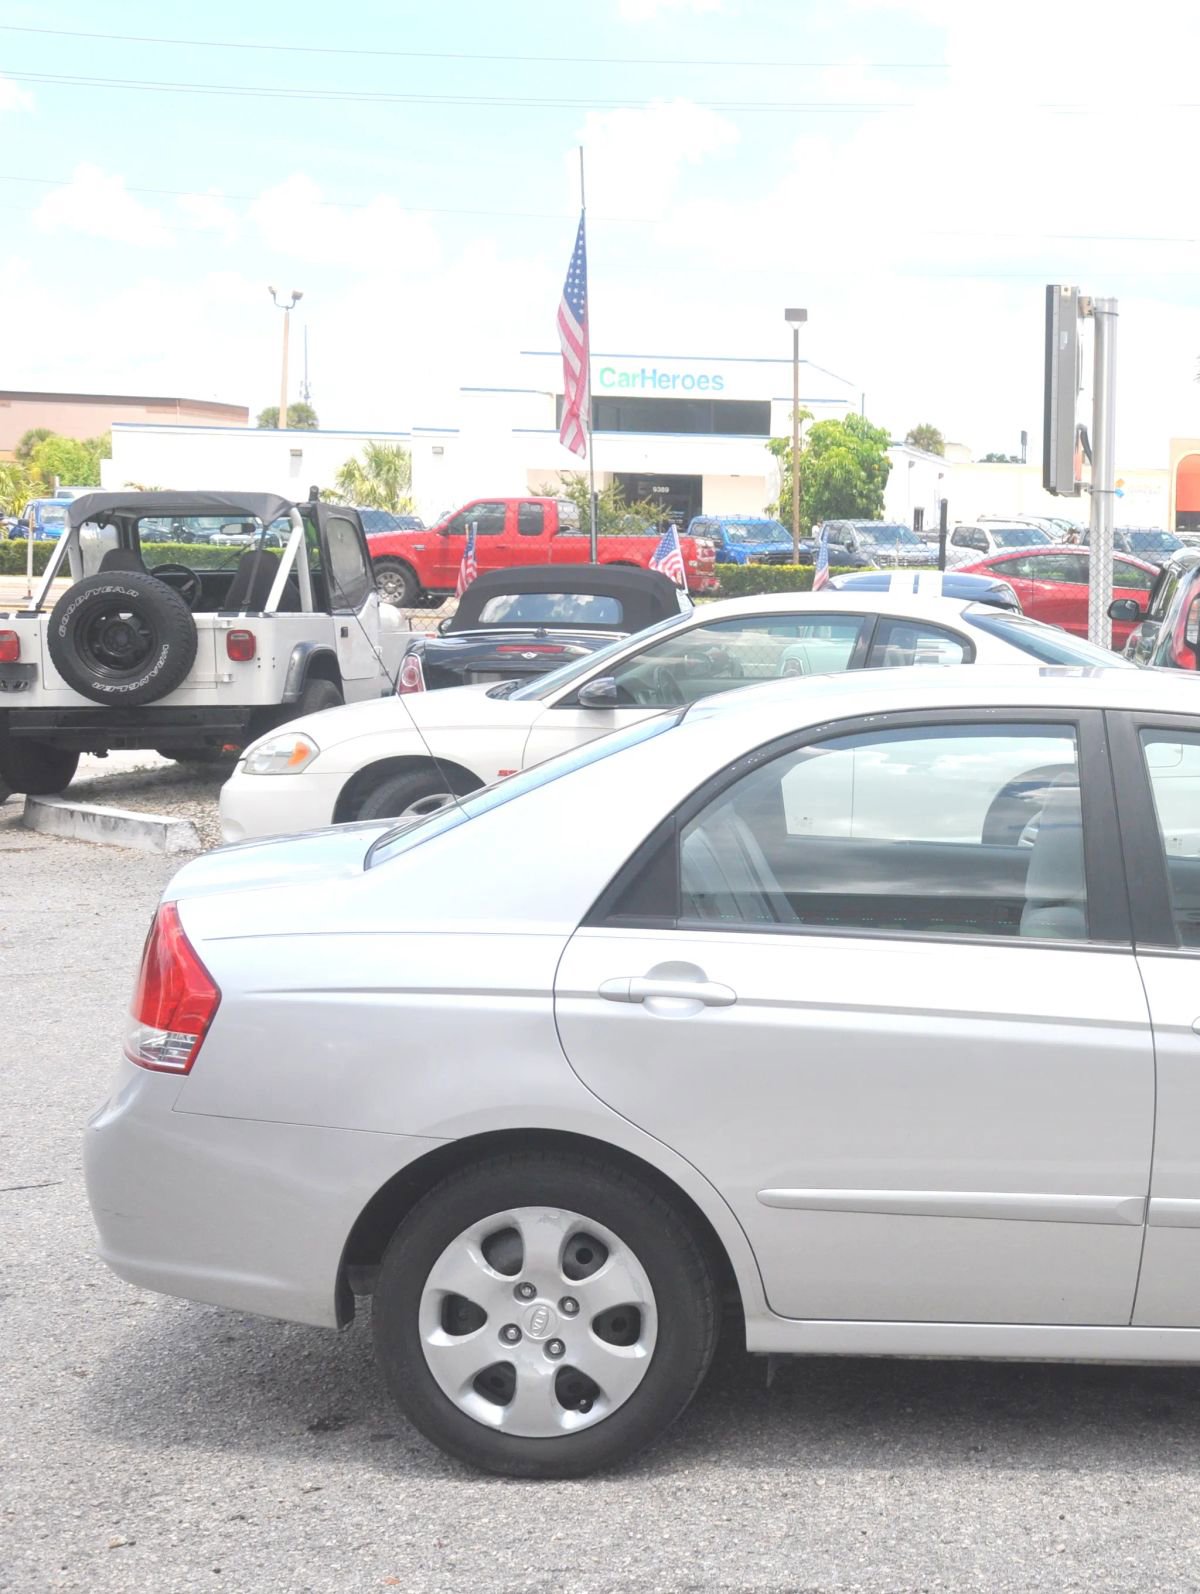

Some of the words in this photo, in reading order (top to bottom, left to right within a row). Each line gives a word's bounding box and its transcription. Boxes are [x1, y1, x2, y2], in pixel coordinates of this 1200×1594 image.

[599, 366, 725, 391] CarHeroes
[58, 586, 139, 638] GOODYEAR
[91, 643, 170, 693] WRANGLER
